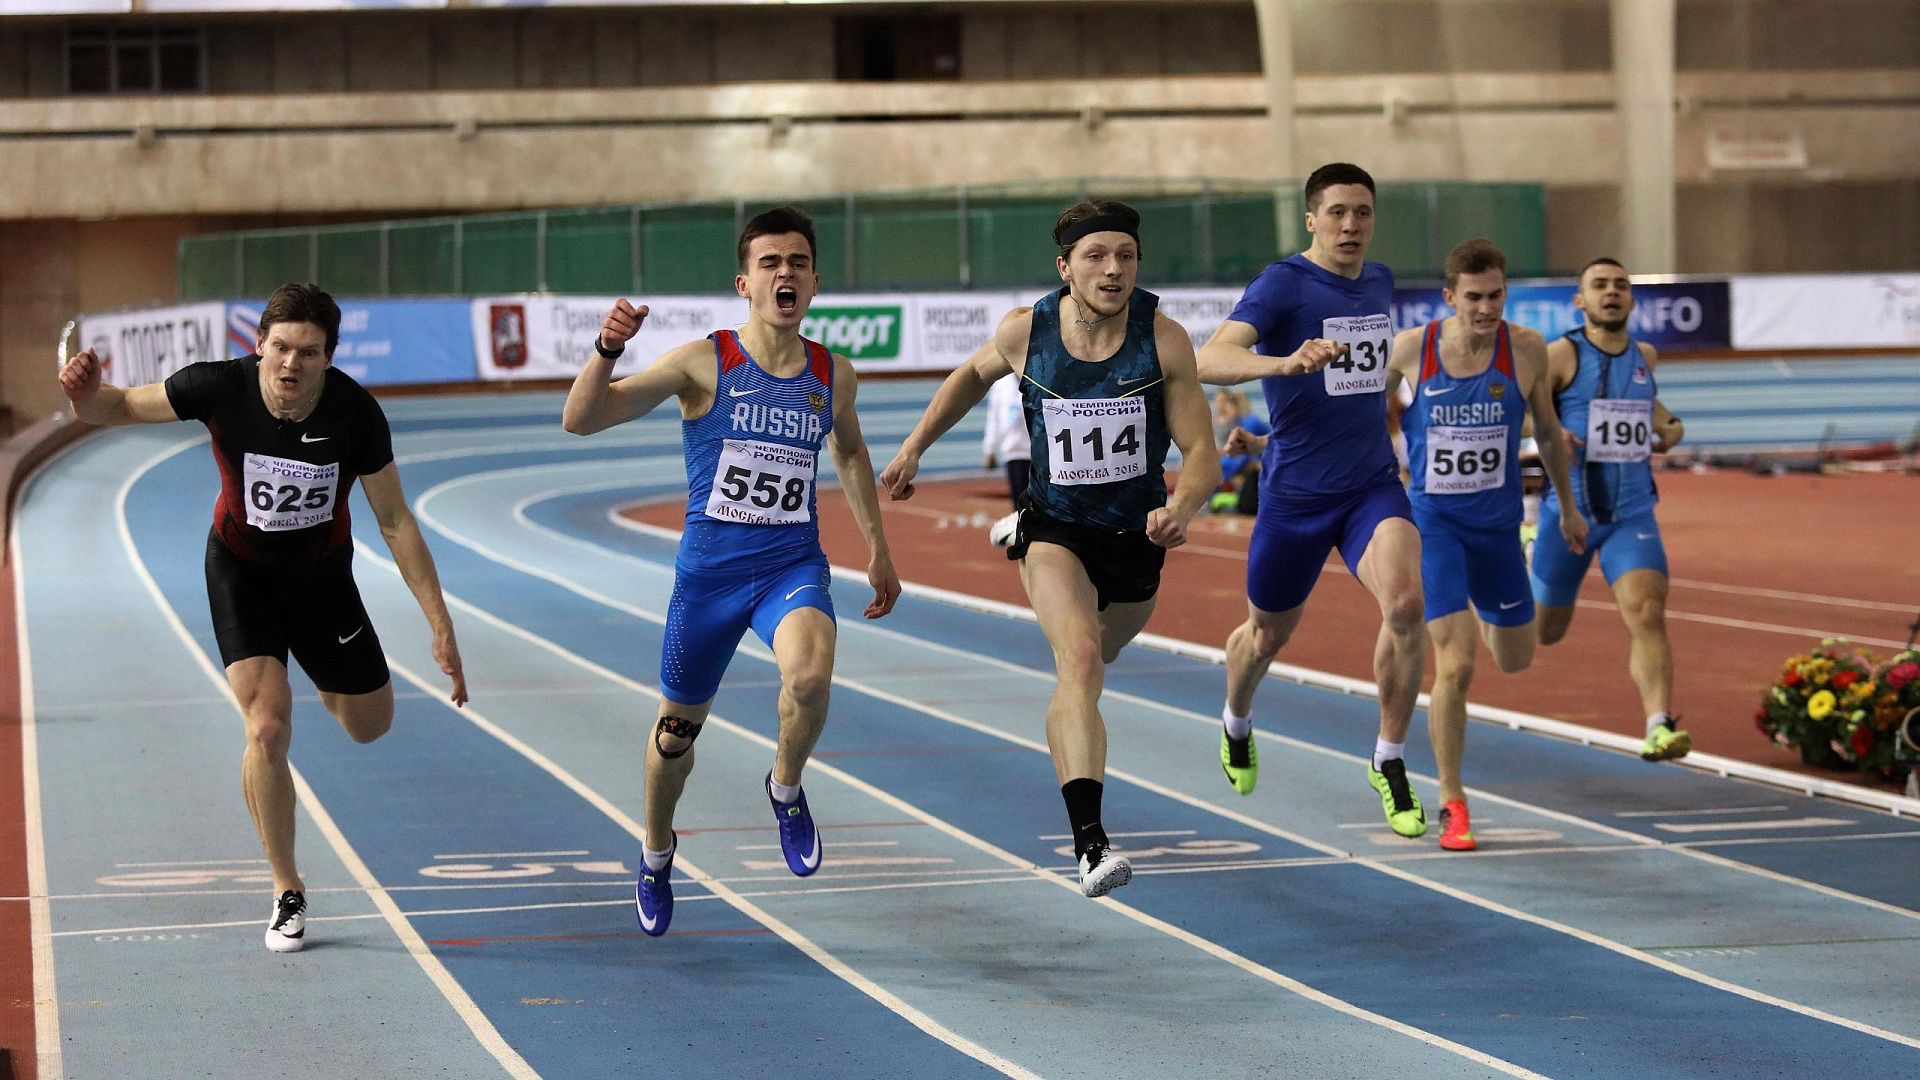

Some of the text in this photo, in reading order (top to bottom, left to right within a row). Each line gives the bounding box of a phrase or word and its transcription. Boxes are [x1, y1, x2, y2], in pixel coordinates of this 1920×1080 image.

[925, 307, 987, 327] РОССИЯ
[1349, 322, 1390, 332] РОССИИ
[1330, 339, 1389, 373] 431
[1334, 379, 1378, 391] МОСКВА
[1072, 400, 1142, 409] ЧЕМПИОНАТ
[1072, 406, 1141, 417] РОССИИ
[1430, 401, 1505, 425] RUSSIA
[730, 402, 822, 443] RUSSIA
[1595, 421, 1648, 445] 190
[755, 445, 813, 460] ЧЕМПИОНАТ
[1055, 424, 1140, 463] 114
[273, 460, 336, 473] ЧЕМПИОНАТ
[753, 451, 812, 468] РОССИИ
[1433, 448, 1501, 476] 569
[272, 467, 335, 480] РОССИИ
[1058, 463, 1139, 480] МОСКВА 2018
[251, 480, 330, 513] 625
[720, 465, 805, 512] 558
[255, 515, 300, 527] МОСКВА
[717, 505, 771, 526] МОСКВА
